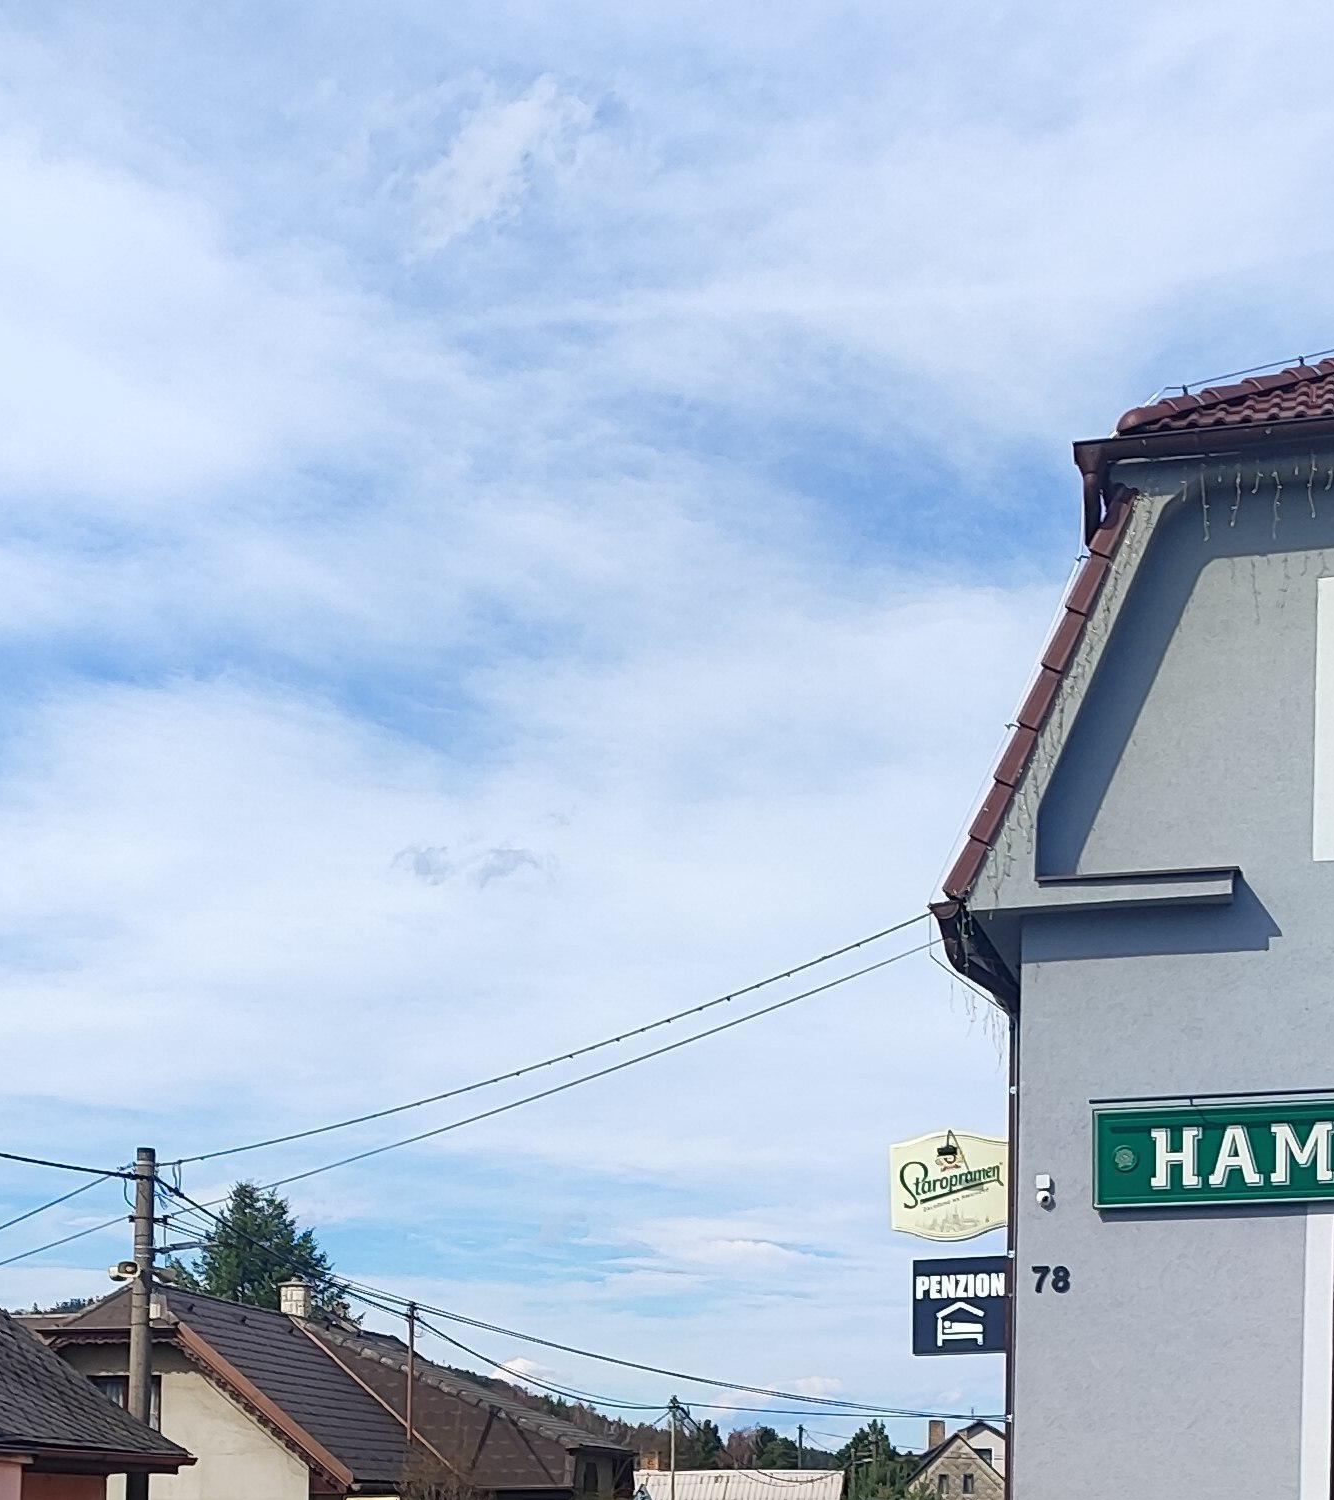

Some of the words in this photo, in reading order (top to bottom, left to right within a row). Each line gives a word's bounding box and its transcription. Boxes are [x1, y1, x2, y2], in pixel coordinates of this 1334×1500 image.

[900, 1161, 1004, 1209] Staropramen
[916, 1272, 1005, 1300] PENZION
[1032, 1265, 1071, 1294] 78
